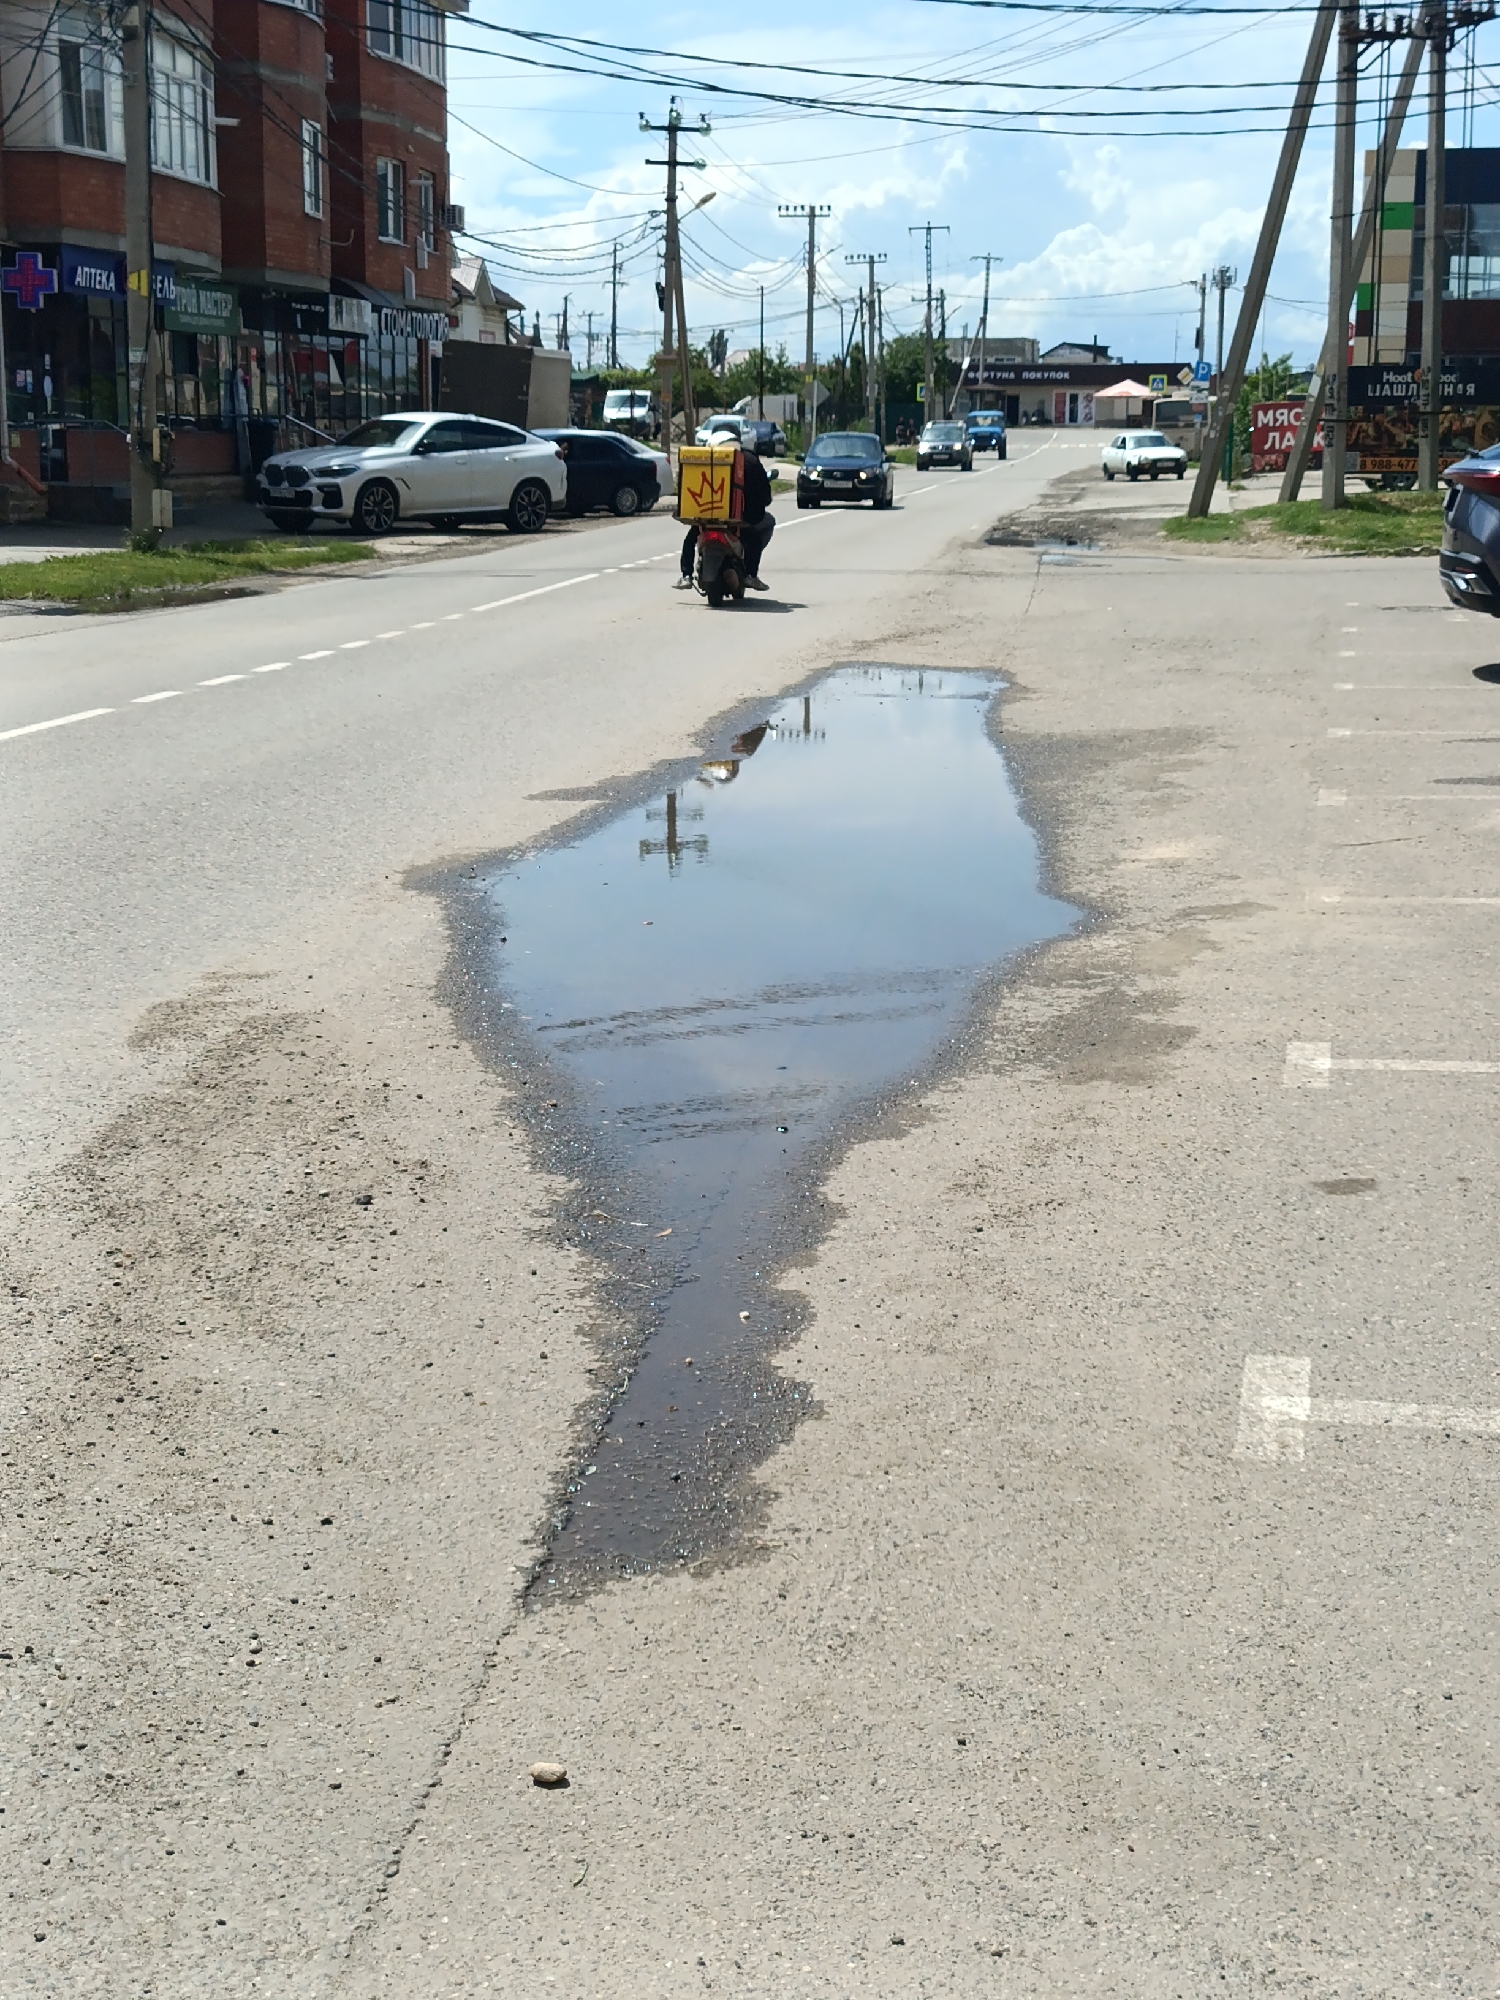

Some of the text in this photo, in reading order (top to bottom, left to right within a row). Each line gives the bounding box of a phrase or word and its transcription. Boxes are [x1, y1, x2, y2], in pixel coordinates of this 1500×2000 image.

[74, 265, 176, 300] АПТЕКА ЕЛЬ
[171, 284, 233, 318] ТРОЙ МАСТЕР
[381, 307, 450, 342] СТОМАТОЛОГИЯ
[1022, 370, 1071, 380] ПОКУПОК
